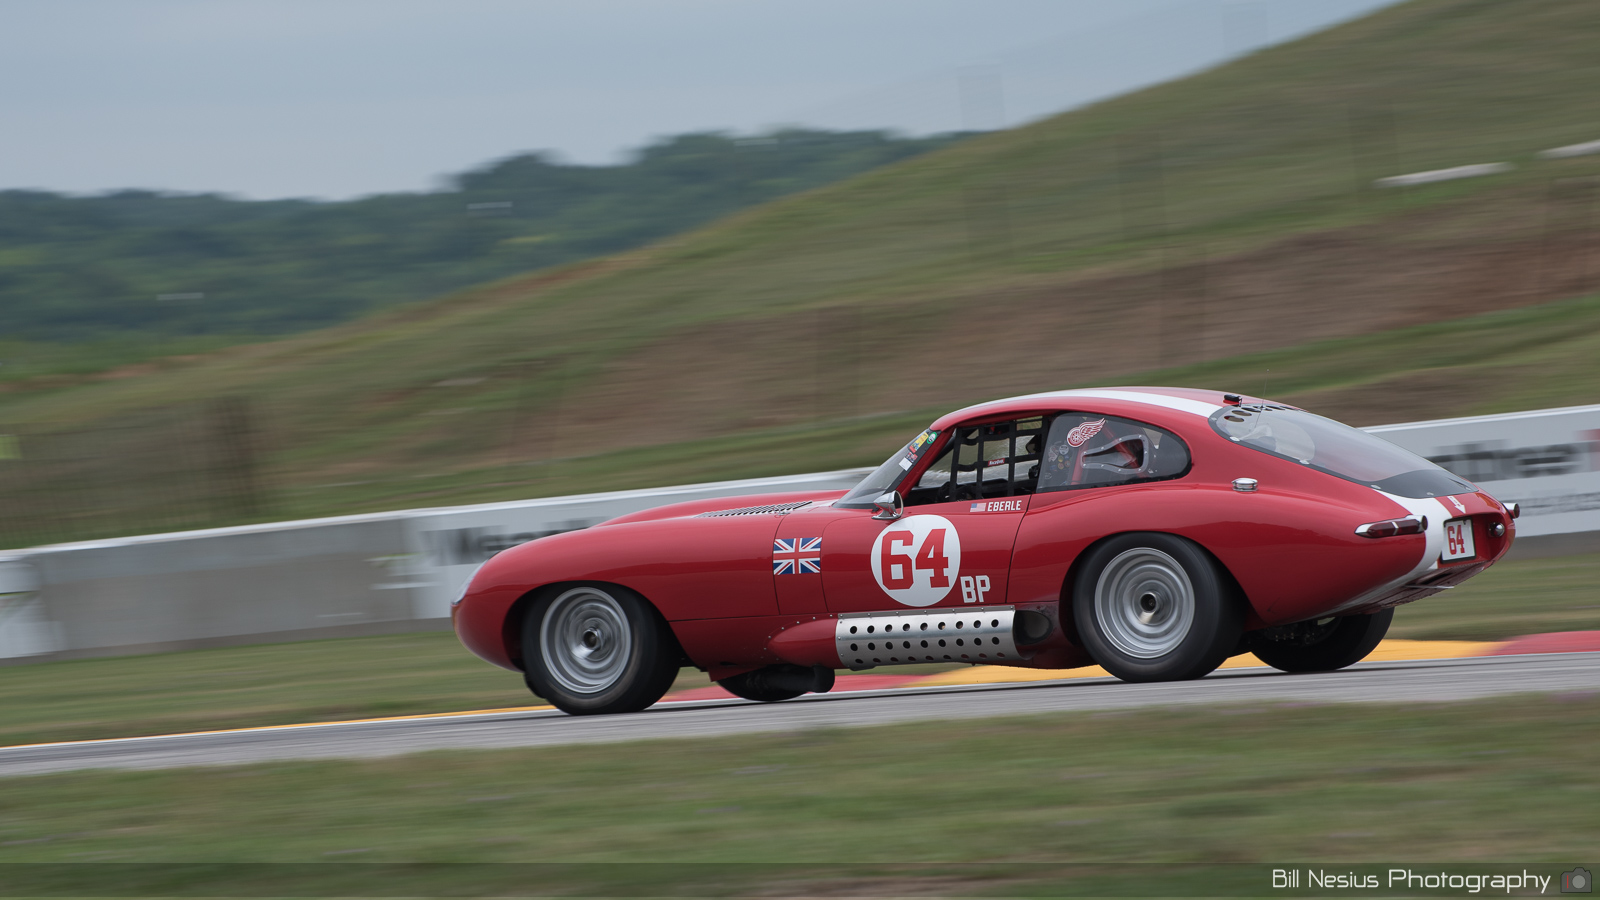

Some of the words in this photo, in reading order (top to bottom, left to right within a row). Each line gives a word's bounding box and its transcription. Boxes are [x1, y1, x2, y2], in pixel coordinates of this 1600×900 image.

[987, 500, 1022, 512] EBERLE
[1447, 524, 1465, 555] 64
[881, 528, 950, 590] 64
[960, 575, 991, 603] BP
